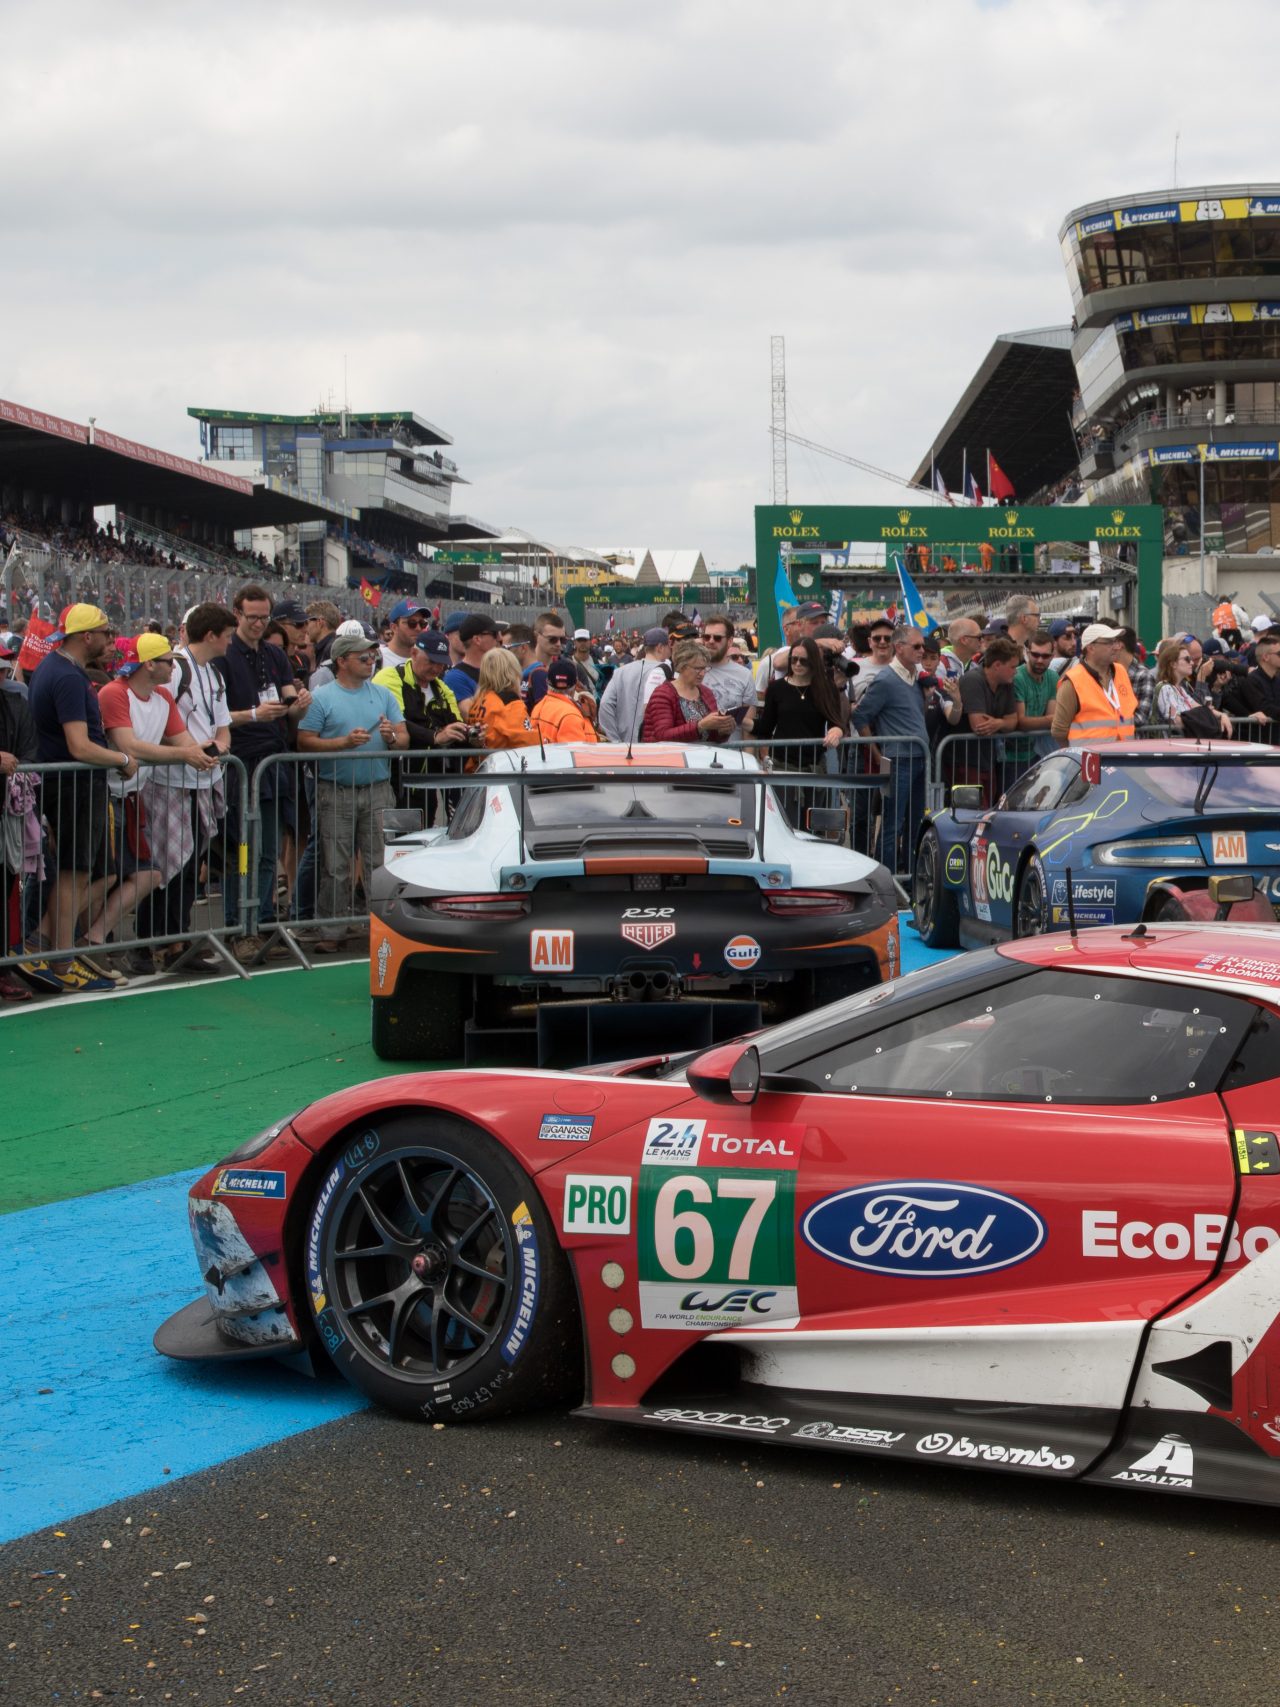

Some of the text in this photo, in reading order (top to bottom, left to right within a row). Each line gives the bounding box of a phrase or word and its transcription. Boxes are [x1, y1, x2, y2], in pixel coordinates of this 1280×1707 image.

[1131, 209, 1177, 222] MICHELIN
[1085, 219, 1113, 233] MICHELIN
[1147, 312, 1188, 323] MICHELIN
[1220, 448, 1275, 456] MICHELIN
[772, 527, 820, 537] ROLEX
[881, 527, 928, 537] ROLEX
[988, 527, 1035, 537] ROLEX
[1095, 526, 1141, 537] ROLEX
[1214, 835, 1246, 860] AM
[1071, 885, 1114, 899] ifestyle
[621, 906, 675, 919] RSR
[1074, 912, 1106, 920] MICHELIN
[624, 924, 674, 940] HEUER
[533, 936, 571, 966] AM
[726, 945, 760, 959] Gulf
[550, 1125, 591, 1135] GANASSI
[707, 1133, 794, 1156] TOTAL
[1237, 1140, 1247, 1160] PUSH
[646, 1148, 692, 1157] LE MANS
[227, 1176, 278, 1192] MICHELIN
[568, 1184, 628, 1226] PRO
[308, 1166, 342, 1272] MICHELIN
[654, 1175, 778, 1281] 67
[849, 1194, 998, 1262] Ford
[503, 1246, 538, 1357] MICHELIN
[679, 1288, 777, 1313] WEC
[685, 1320, 742, 1328] CHAMPIONSHIP
[695, 1314, 743, 1322] ENDURANCE
[646, 1407, 791, 1433] sparco
[951, 1435, 1075, 1471] brembo
[1111, 1470, 1193, 1488] AXALTA
